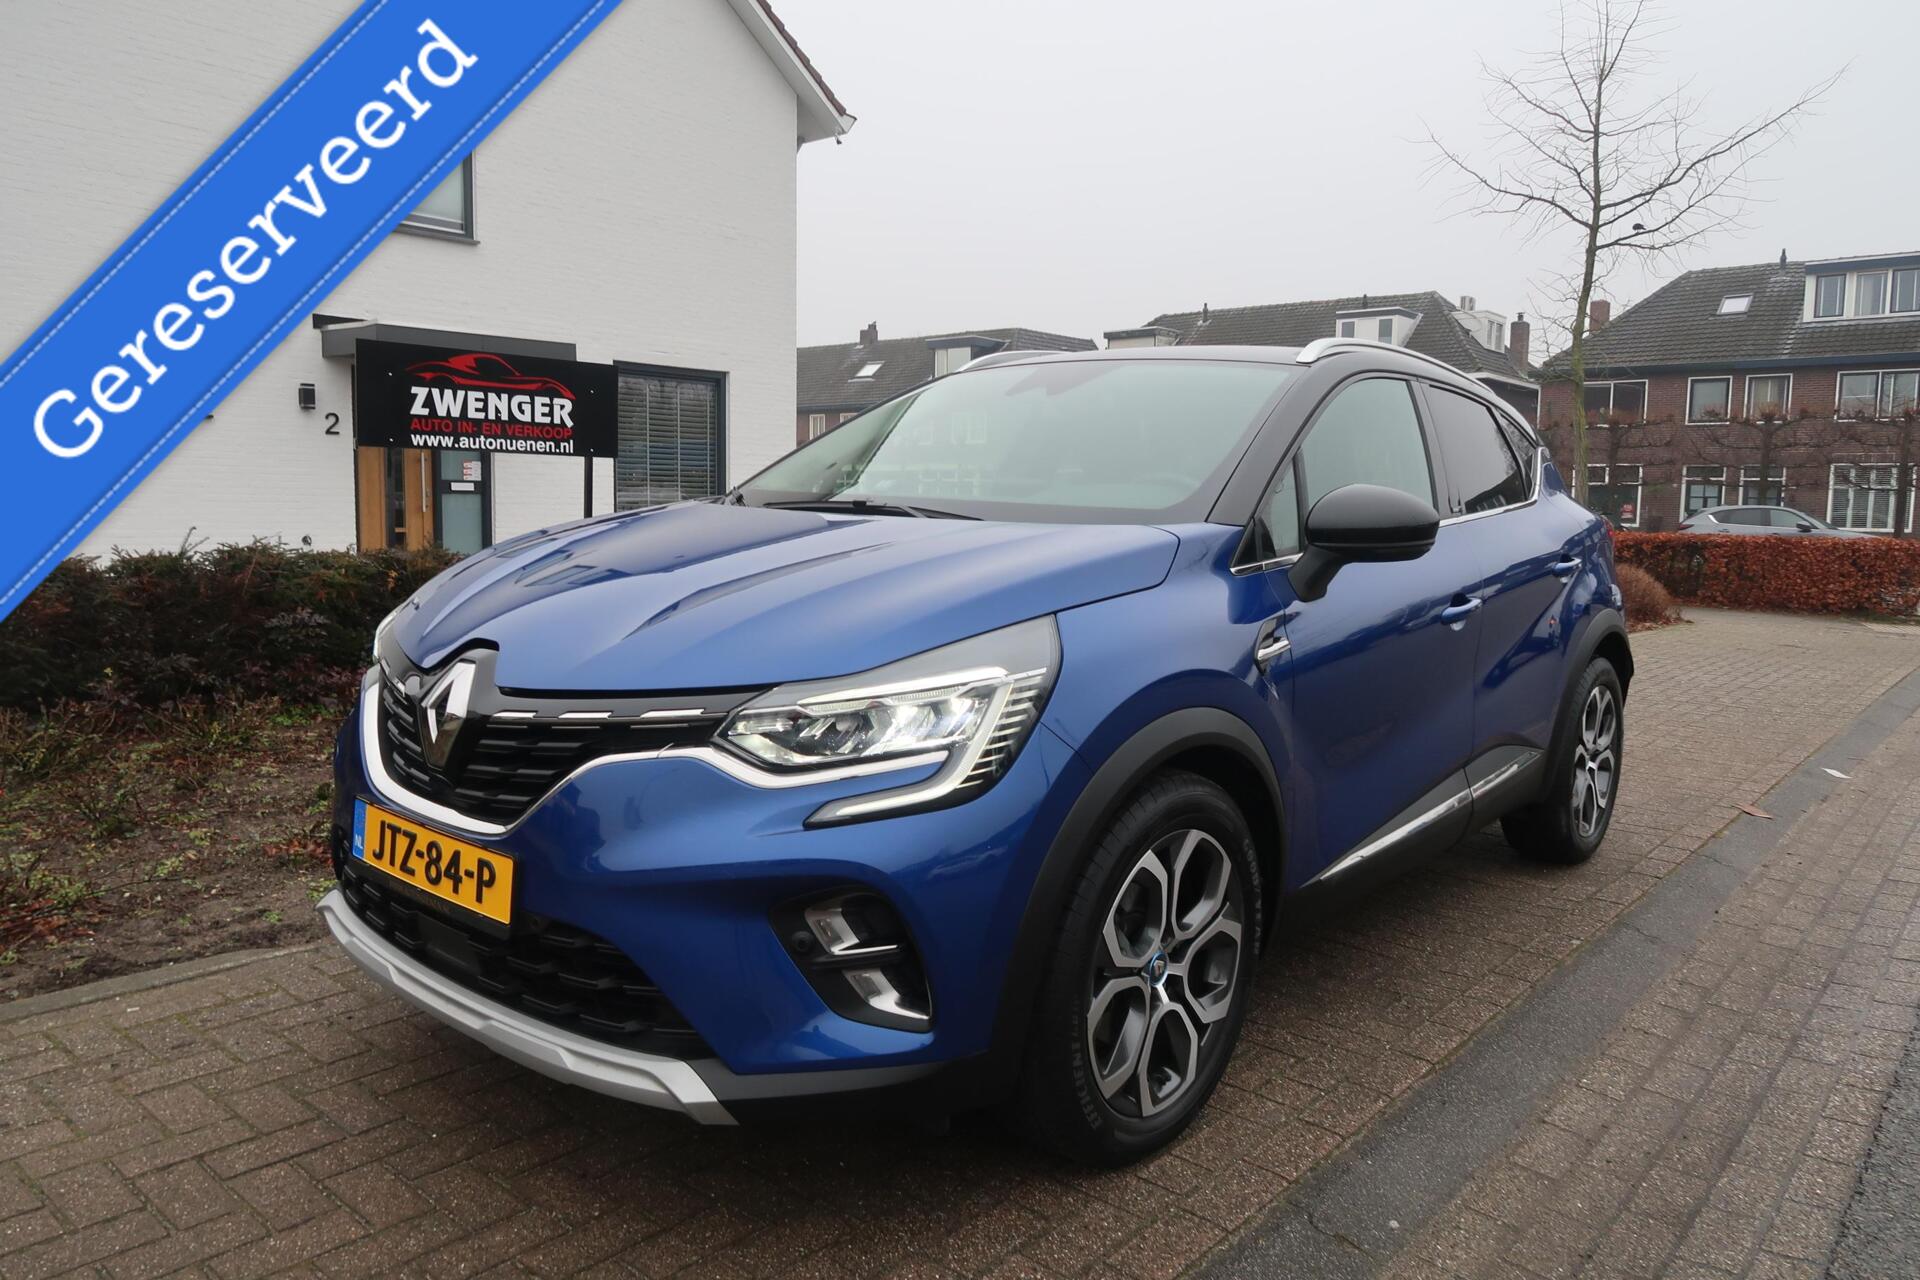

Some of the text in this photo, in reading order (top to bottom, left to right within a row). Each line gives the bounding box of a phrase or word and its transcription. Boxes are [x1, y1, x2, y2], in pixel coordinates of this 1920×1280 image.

[409, 386, 574, 428] ZWENGER
[325, 412, 340, 435] 2
[410, 418, 573, 439] AUTO IN- EN VERKOOP
[410, 434, 574, 453] www.autonuenen.nl
[354, 835, 363, 849] NL
[372, 820, 497, 904] JTZ-84-P
